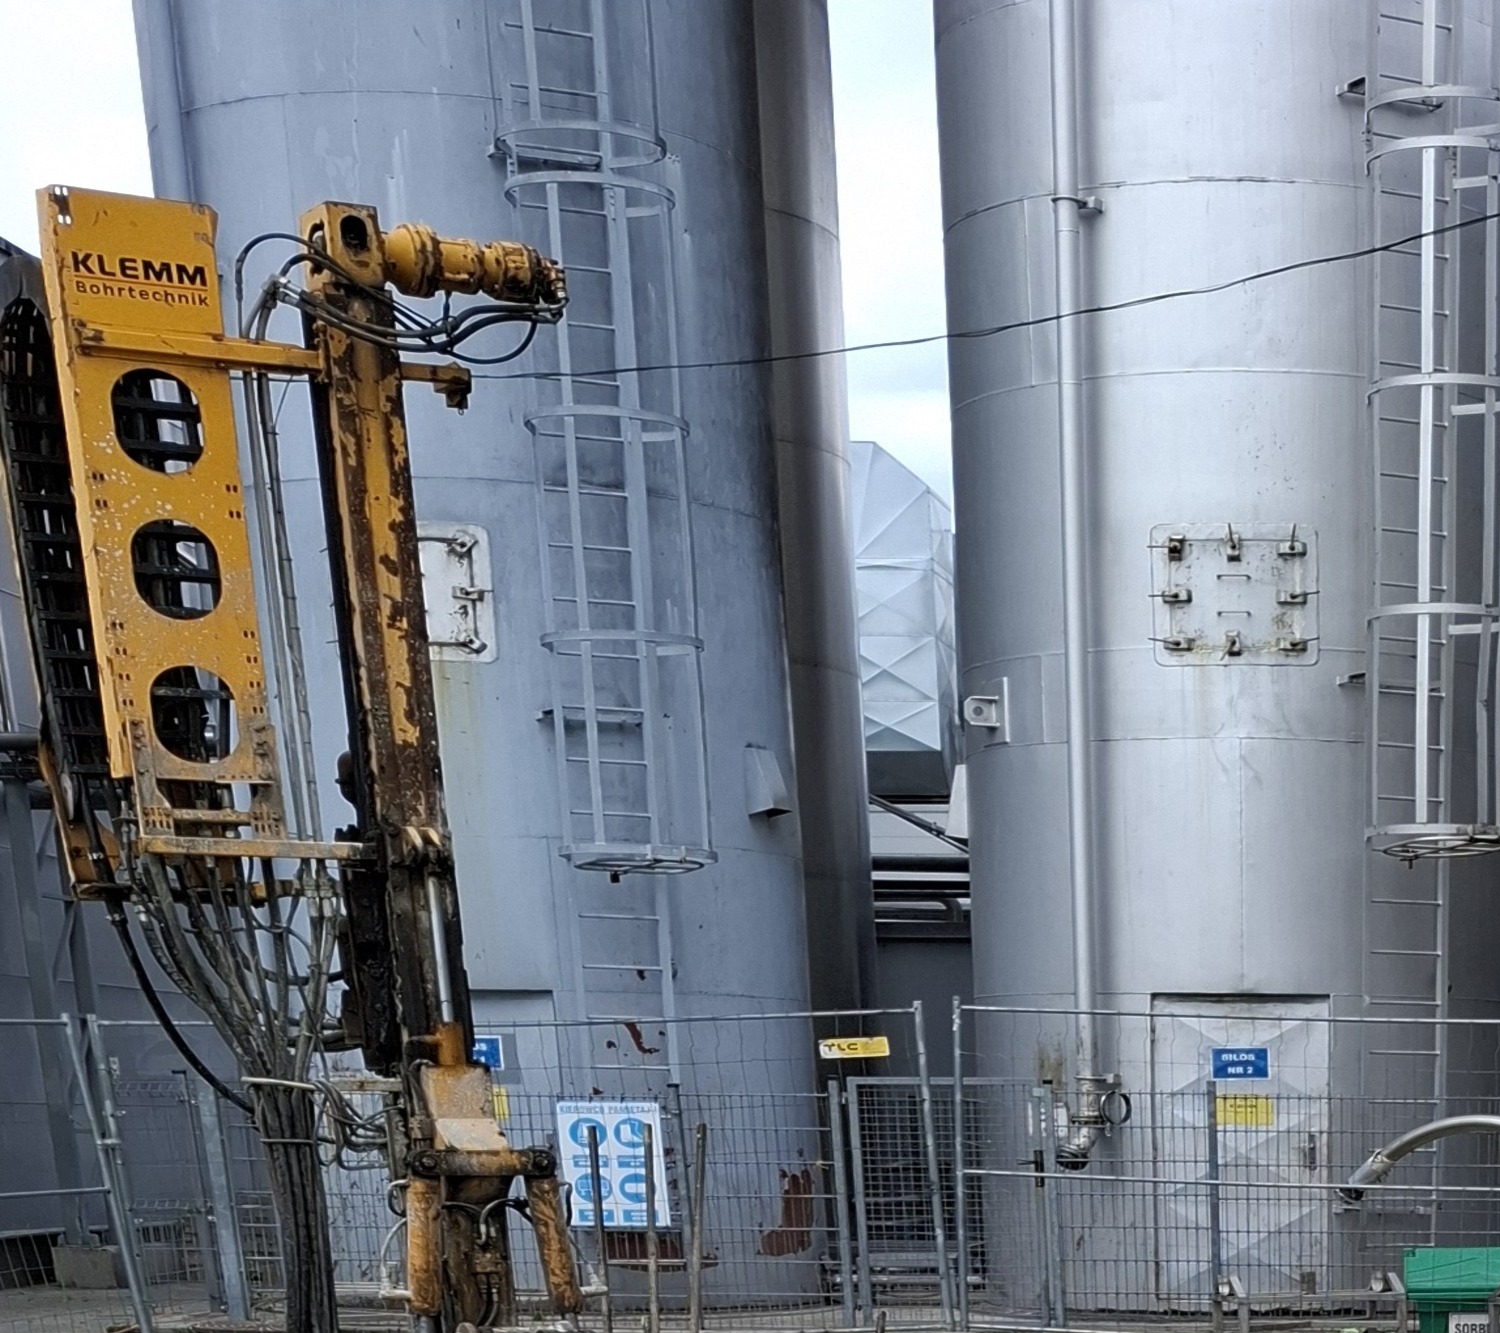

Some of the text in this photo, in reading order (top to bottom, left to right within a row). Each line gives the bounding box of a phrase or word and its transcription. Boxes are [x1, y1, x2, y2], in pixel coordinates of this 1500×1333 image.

[71, 251, 207, 287] KLEMM
[76, 280, 209, 307] Bohrtechnik
[1221, 1053, 1256, 1061] SILOS
[1227, 1066, 1254, 1074] NR 2
